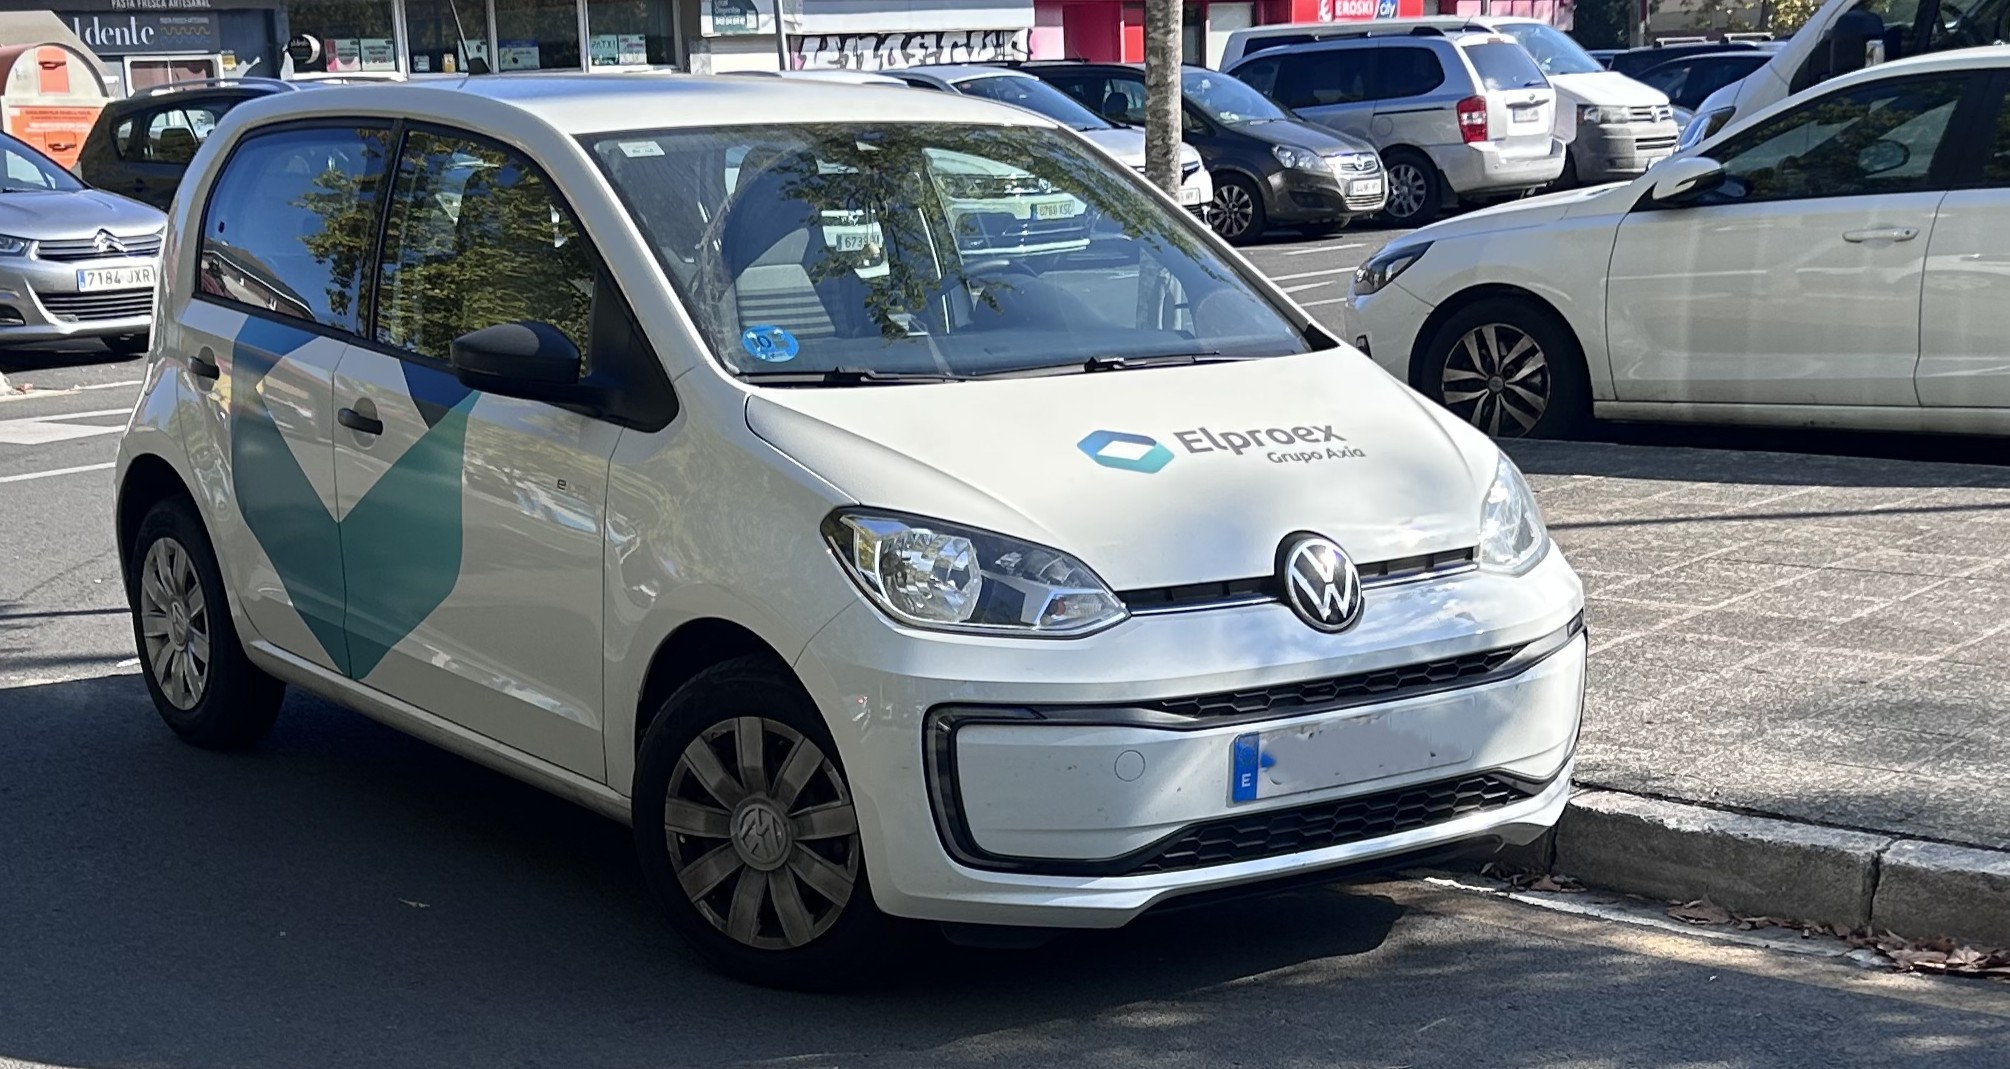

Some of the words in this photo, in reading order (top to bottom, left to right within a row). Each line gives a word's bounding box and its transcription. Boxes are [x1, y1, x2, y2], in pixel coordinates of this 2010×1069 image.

[1335, 0, 1374, 16] EROSKI
[87, 272, 122, 287] 7184
[127, 269, 151, 284] JXR
[1173, 425, 1347, 456] Elproex
[1267, 451, 1324, 464] Grupo
[1326, 446, 1367, 461] Axia
[1241, 773, 1252, 787] E
